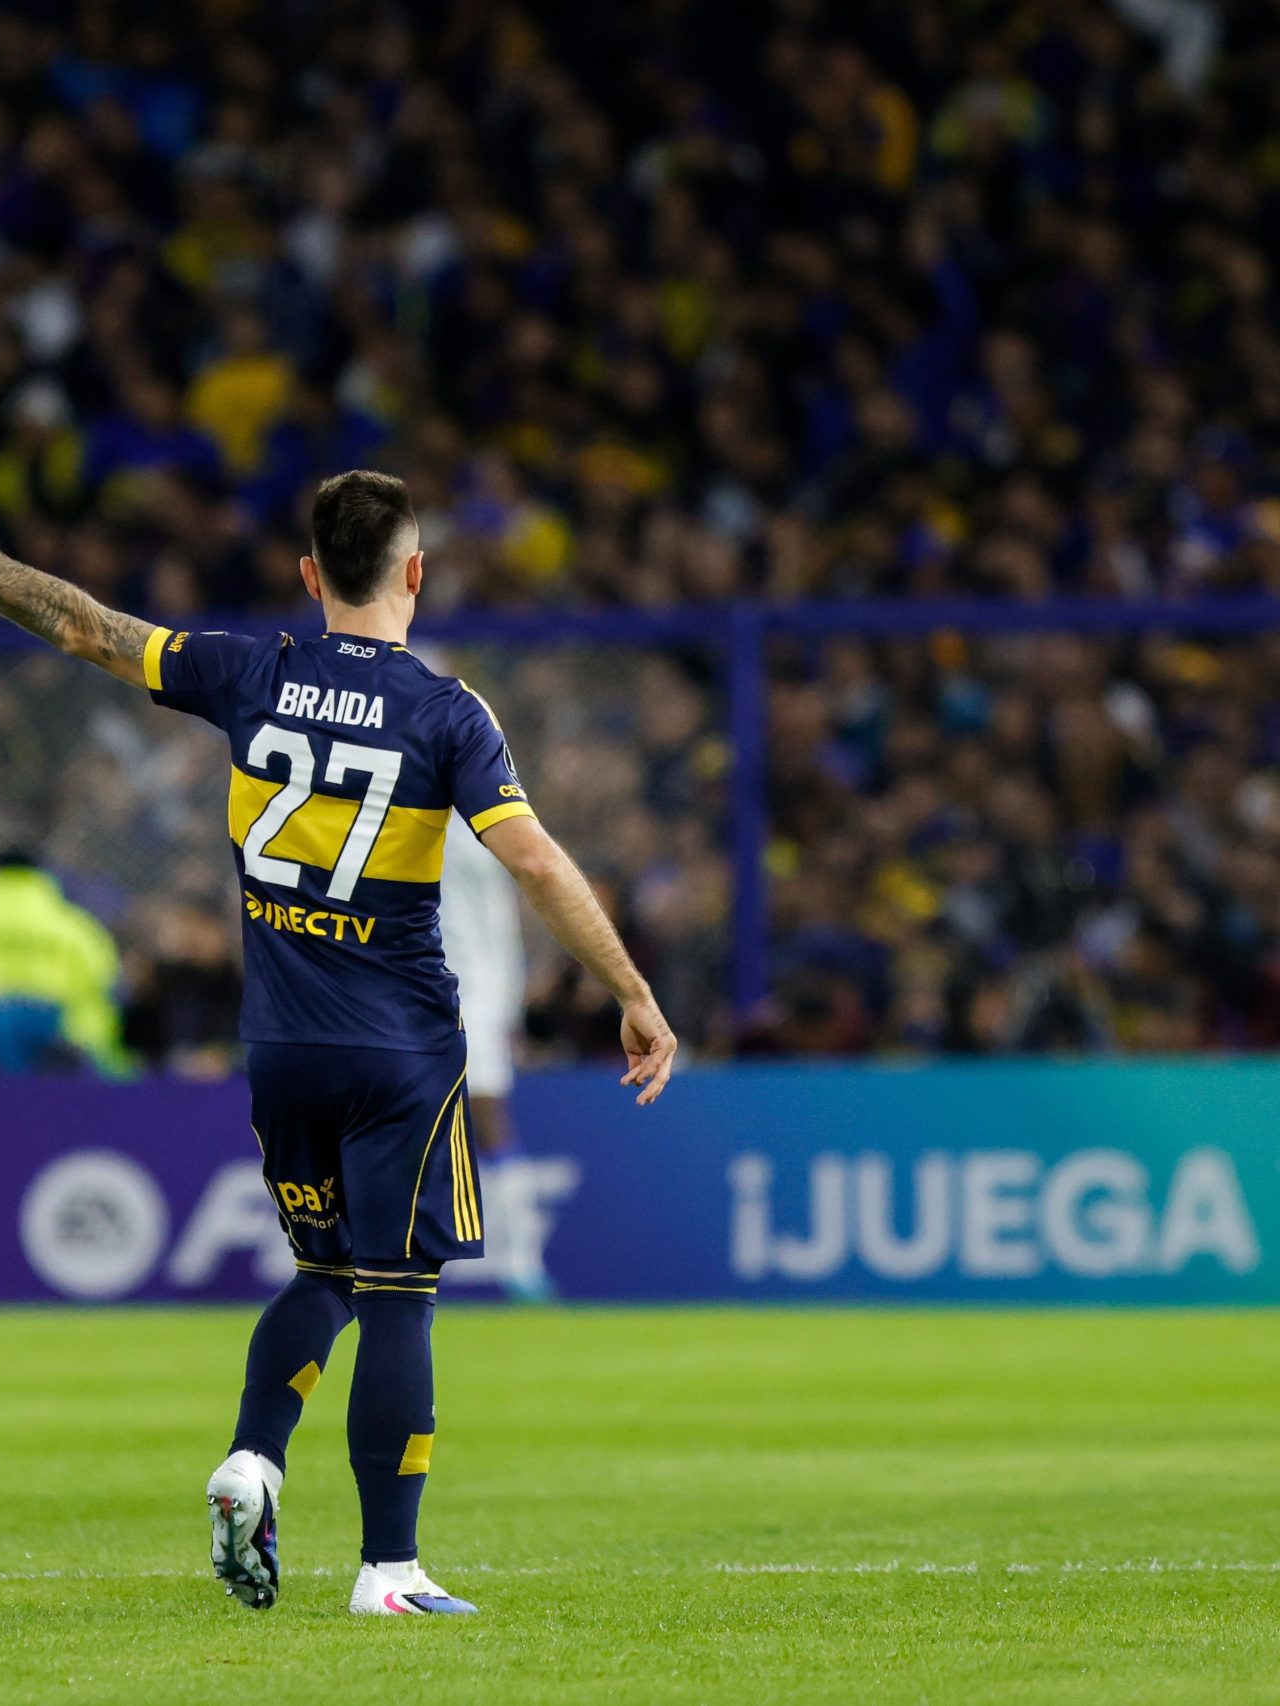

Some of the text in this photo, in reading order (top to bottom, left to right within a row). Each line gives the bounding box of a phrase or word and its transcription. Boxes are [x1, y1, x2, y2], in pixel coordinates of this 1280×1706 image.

[336, 641, 377, 659] 1905
[276, 682, 384, 729] BRAIDA
[243, 723, 403, 902] 27
[244, 890, 376, 944] DIRECTV
